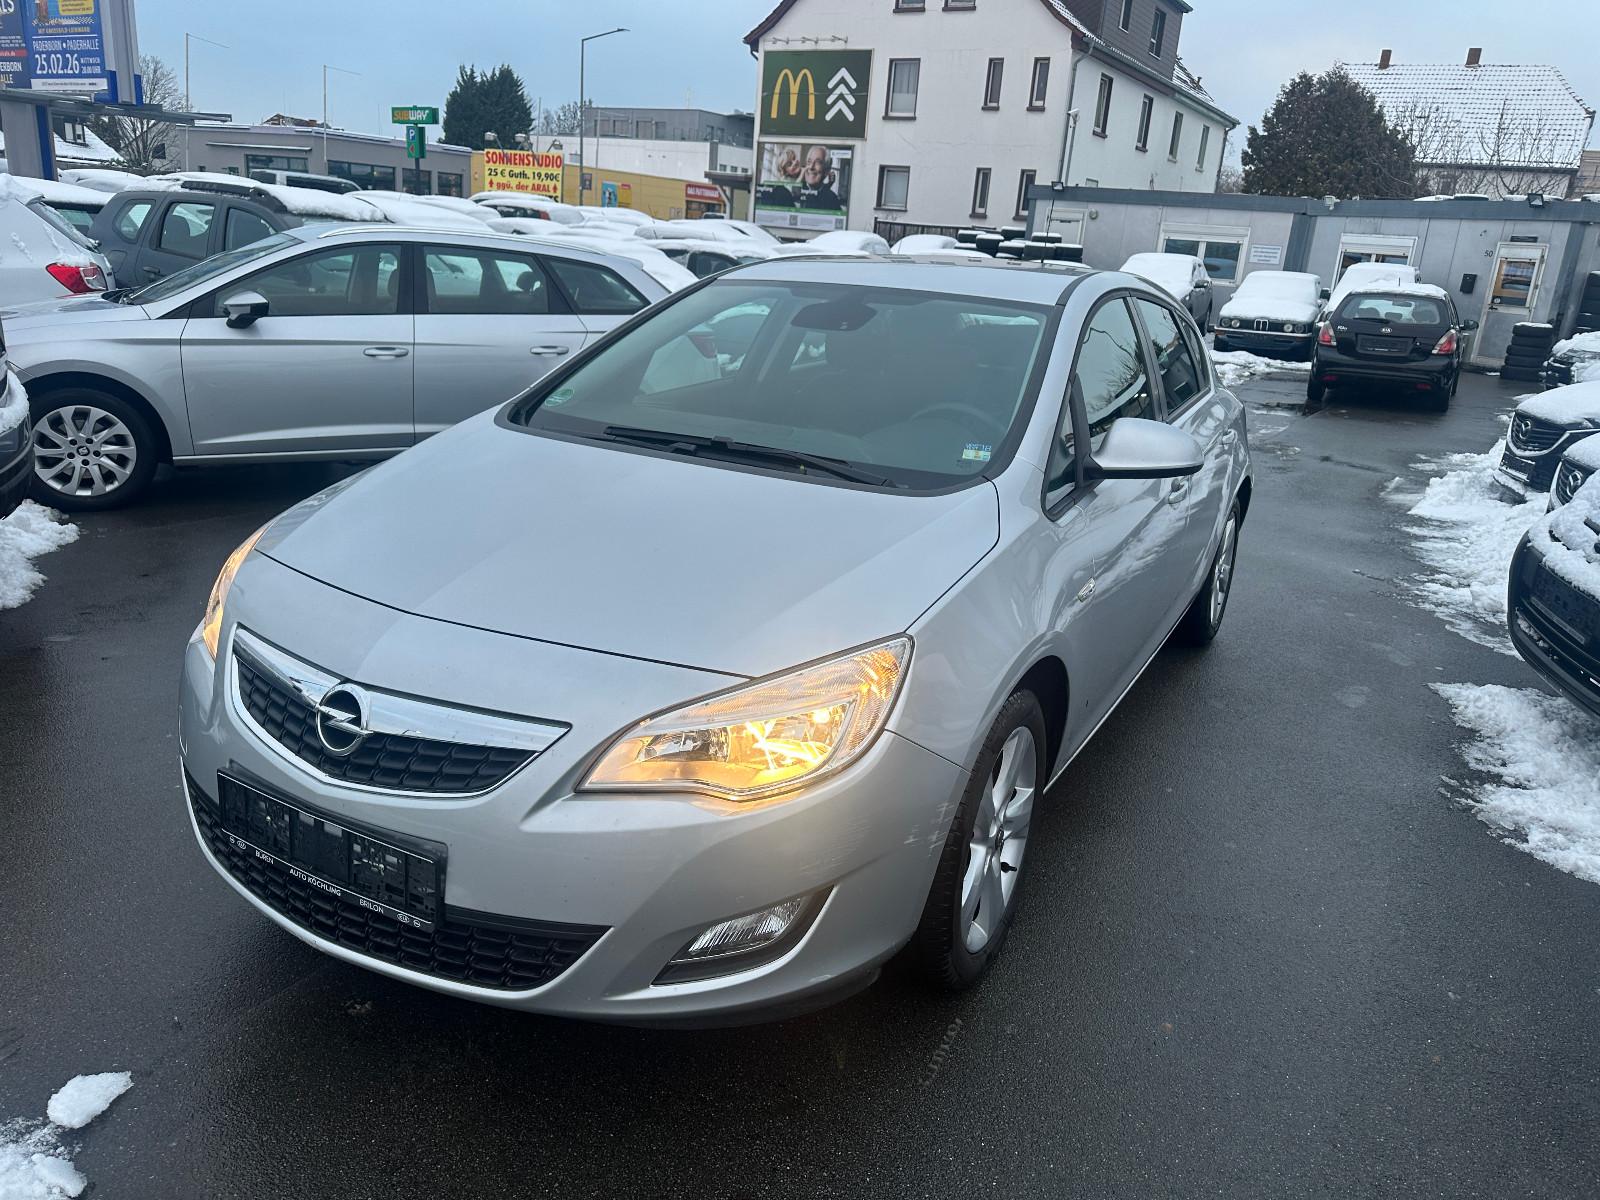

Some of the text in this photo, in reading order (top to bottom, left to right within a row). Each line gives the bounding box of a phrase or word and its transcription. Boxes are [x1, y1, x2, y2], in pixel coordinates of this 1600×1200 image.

[32, 40, 62, 51] PADERBORN
[66, 39, 100, 50] PADERHALLE
[35, 53, 80, 75] 25.02.26
[393, 110, 429, 121] SUBWAY
[409, 129, 416, 141] P
[485, 151, 562, 169] SONNENSTUDIO
[487, 168, 560, 183] 25 € Guth. 19,90€
[496, 181, 551, 193] ggü. der ARAL
[1484, 250, 1494, 258] 50
[289, 868, 307, 881] AUTO
[307, 876, 342, 897] KÖCHLING
[359, 899, 384, 914] BRILON
